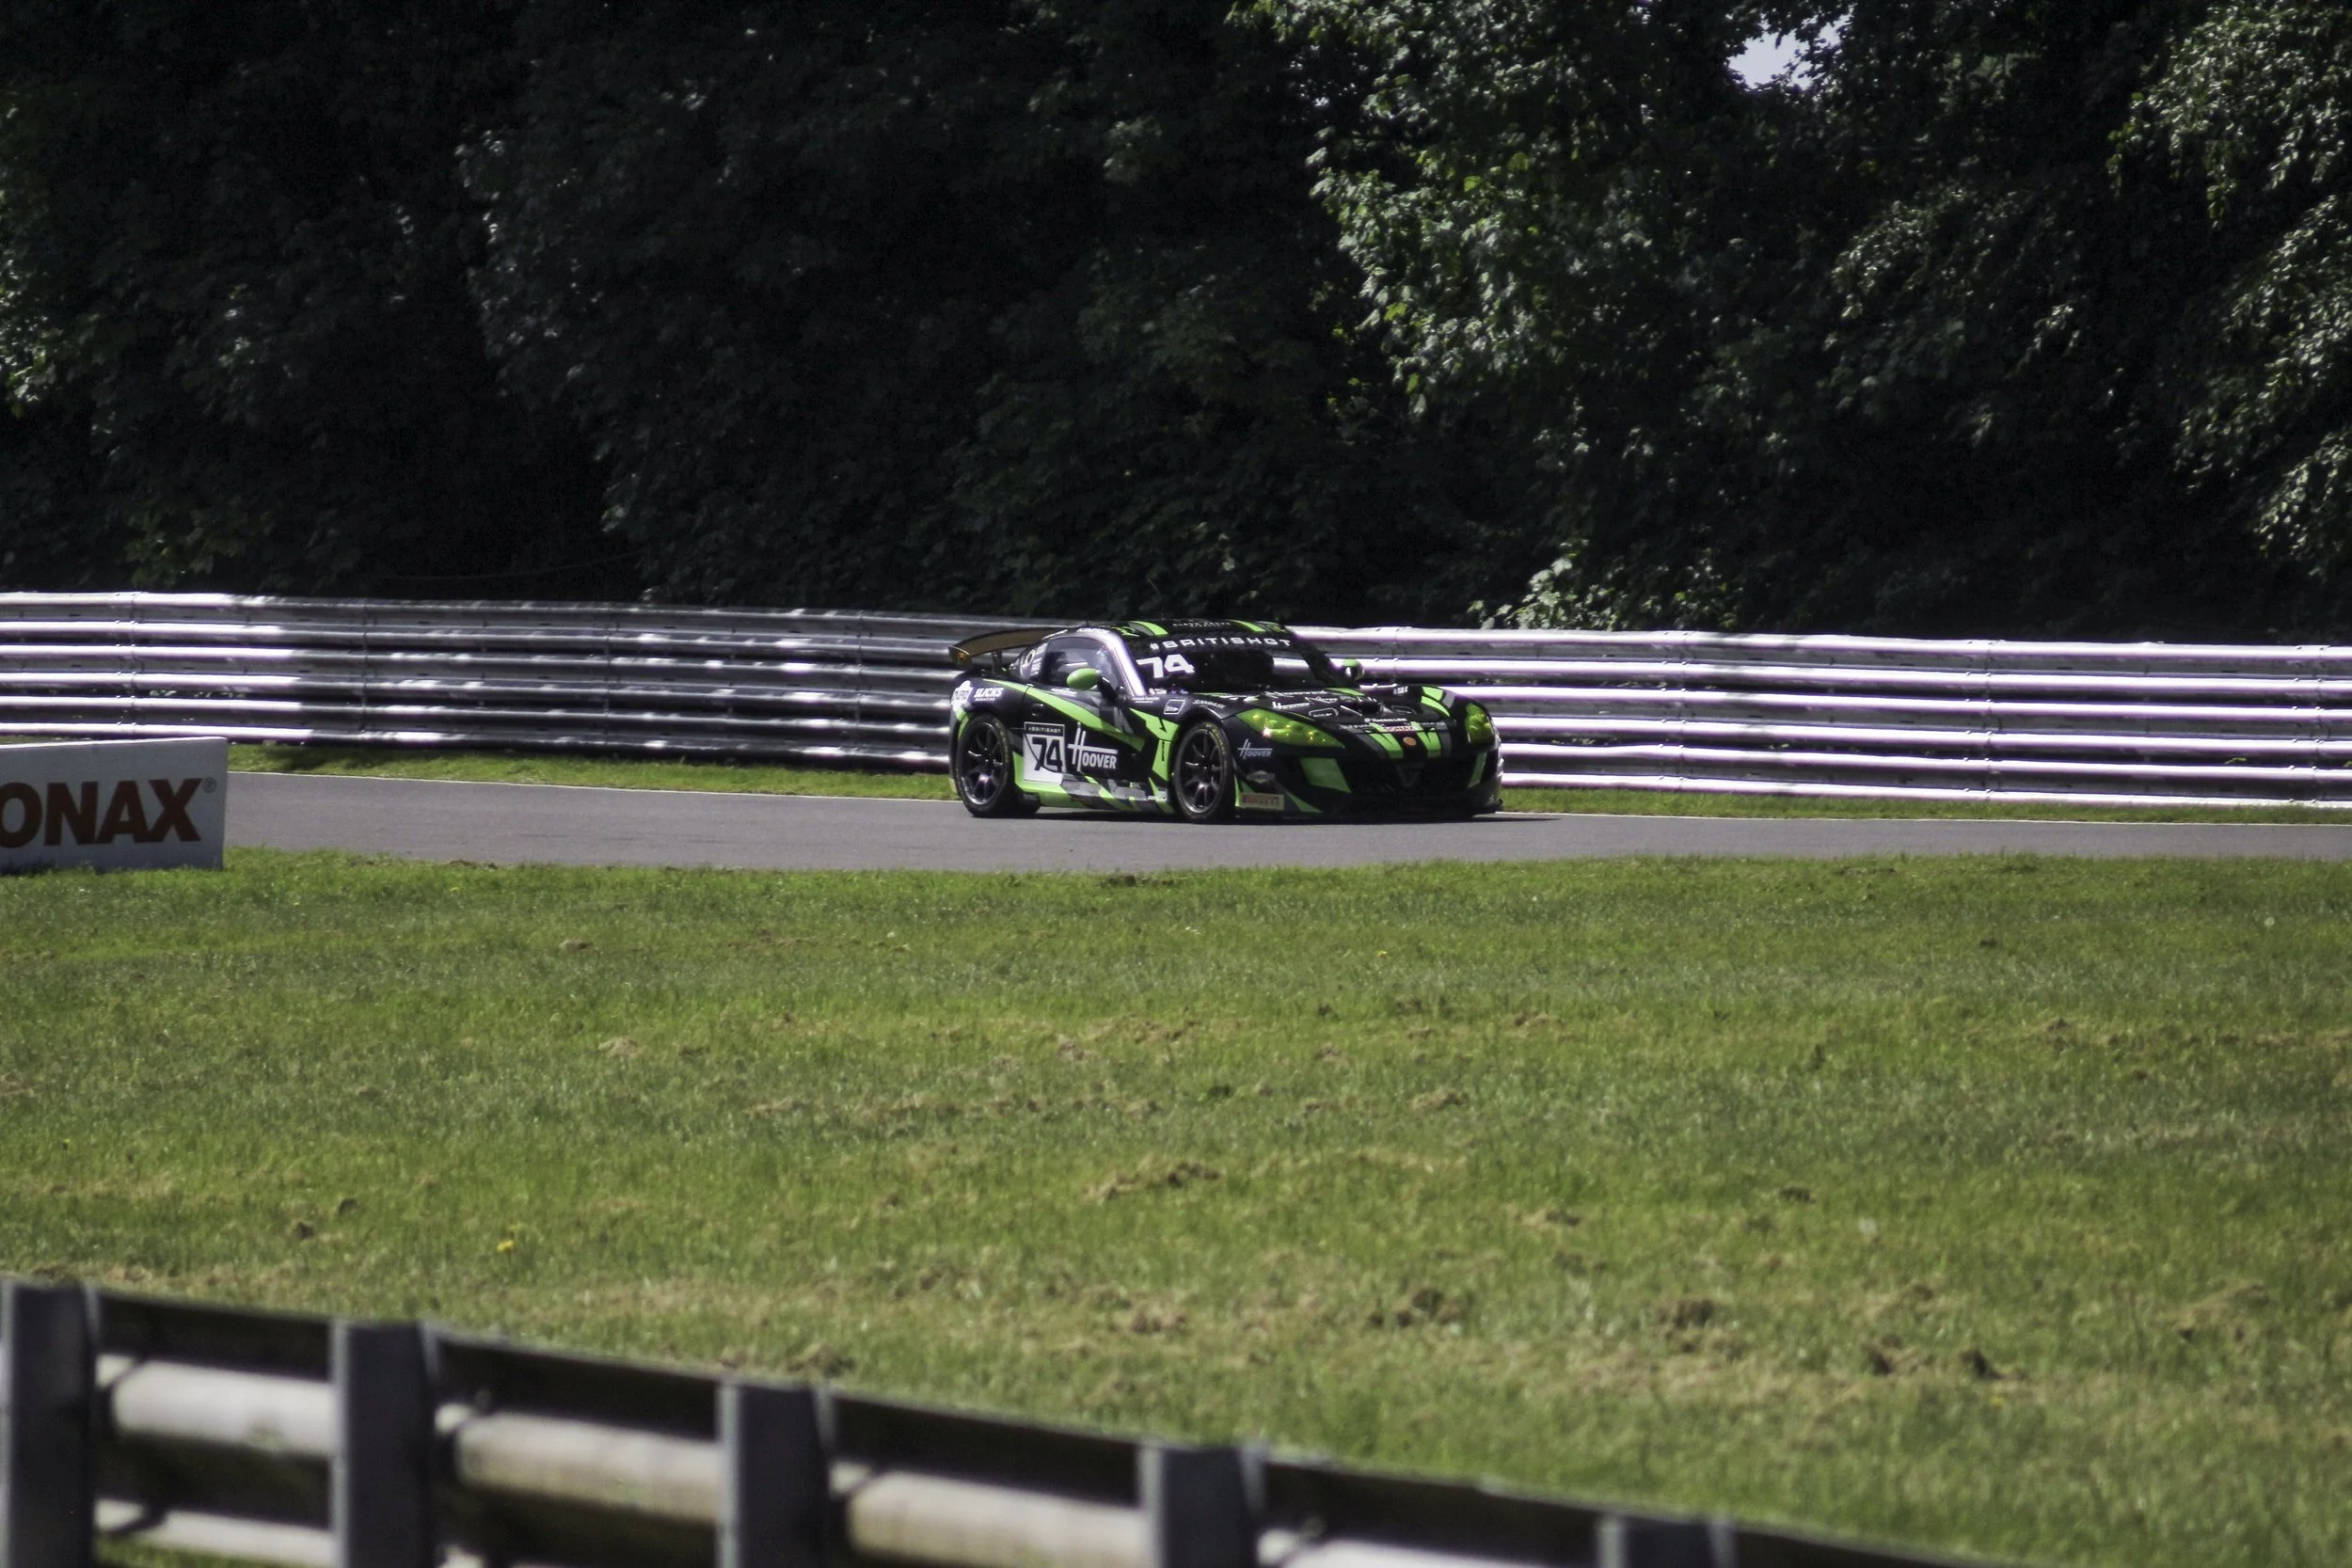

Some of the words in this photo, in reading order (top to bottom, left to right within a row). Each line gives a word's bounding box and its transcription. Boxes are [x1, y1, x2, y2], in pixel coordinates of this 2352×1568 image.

[1149, 637, 1291, 650] #BRITISHGT
[1136, 654, 1196, 678] 74
[1032, 736, 1063, 771] 74
[1067, 721, 1119, 771] HOOVER
[1237, 738, 1273, 760] HOOVER
